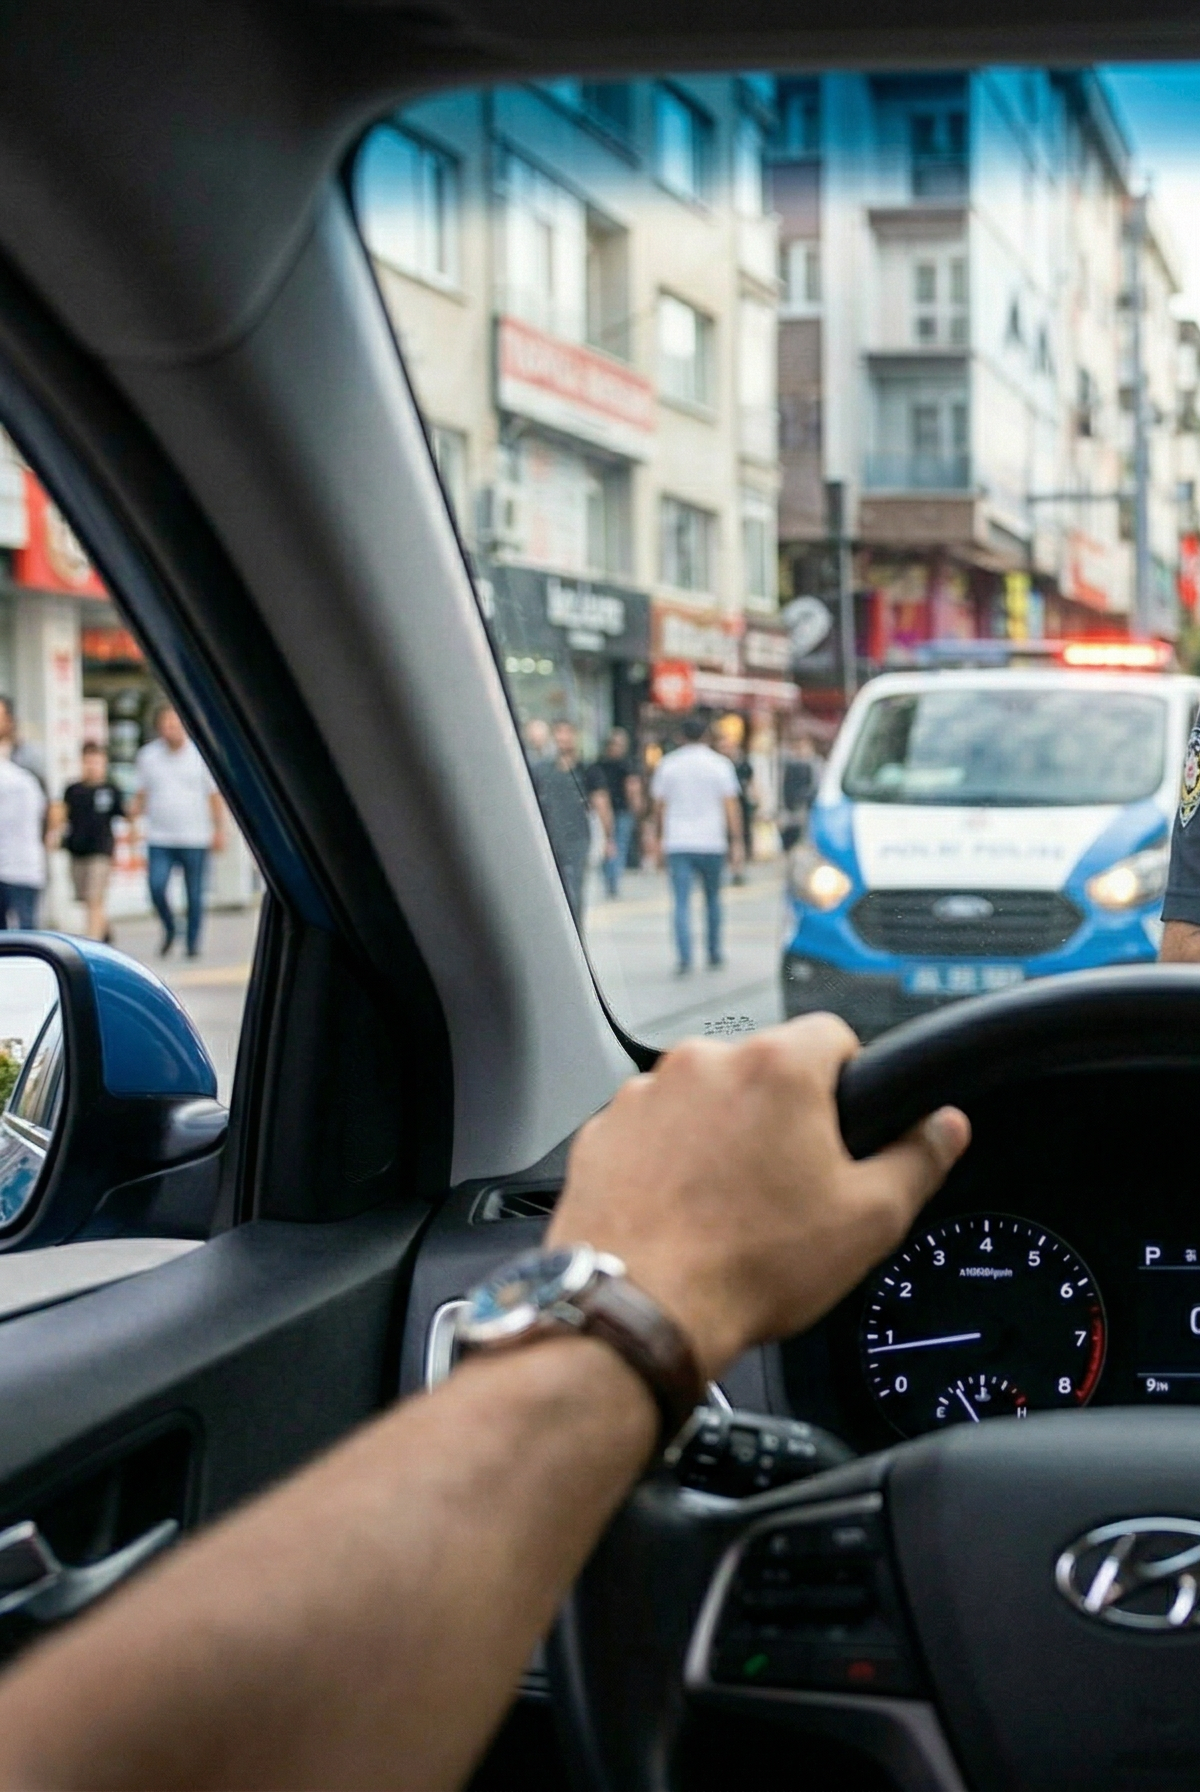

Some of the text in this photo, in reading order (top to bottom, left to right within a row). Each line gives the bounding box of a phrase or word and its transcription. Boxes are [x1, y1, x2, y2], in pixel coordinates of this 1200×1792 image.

[979, 1236, 994, 1253] 4
[932, 1249, 946, 1266] 3
[1027, 1250, 1041, 1267] 5
[1145, 1245, 1162, 1266] P
[899, 1281, 912, 1298] 2
[1060, 1282, 1074, 1299] 6
[885, 1329, 894, 1345] 1
[1074, 1330, 1087, 1347] 7
[894, 1375, 908, 1393] 0
[1057, 1376, 1072, 1394] 8
